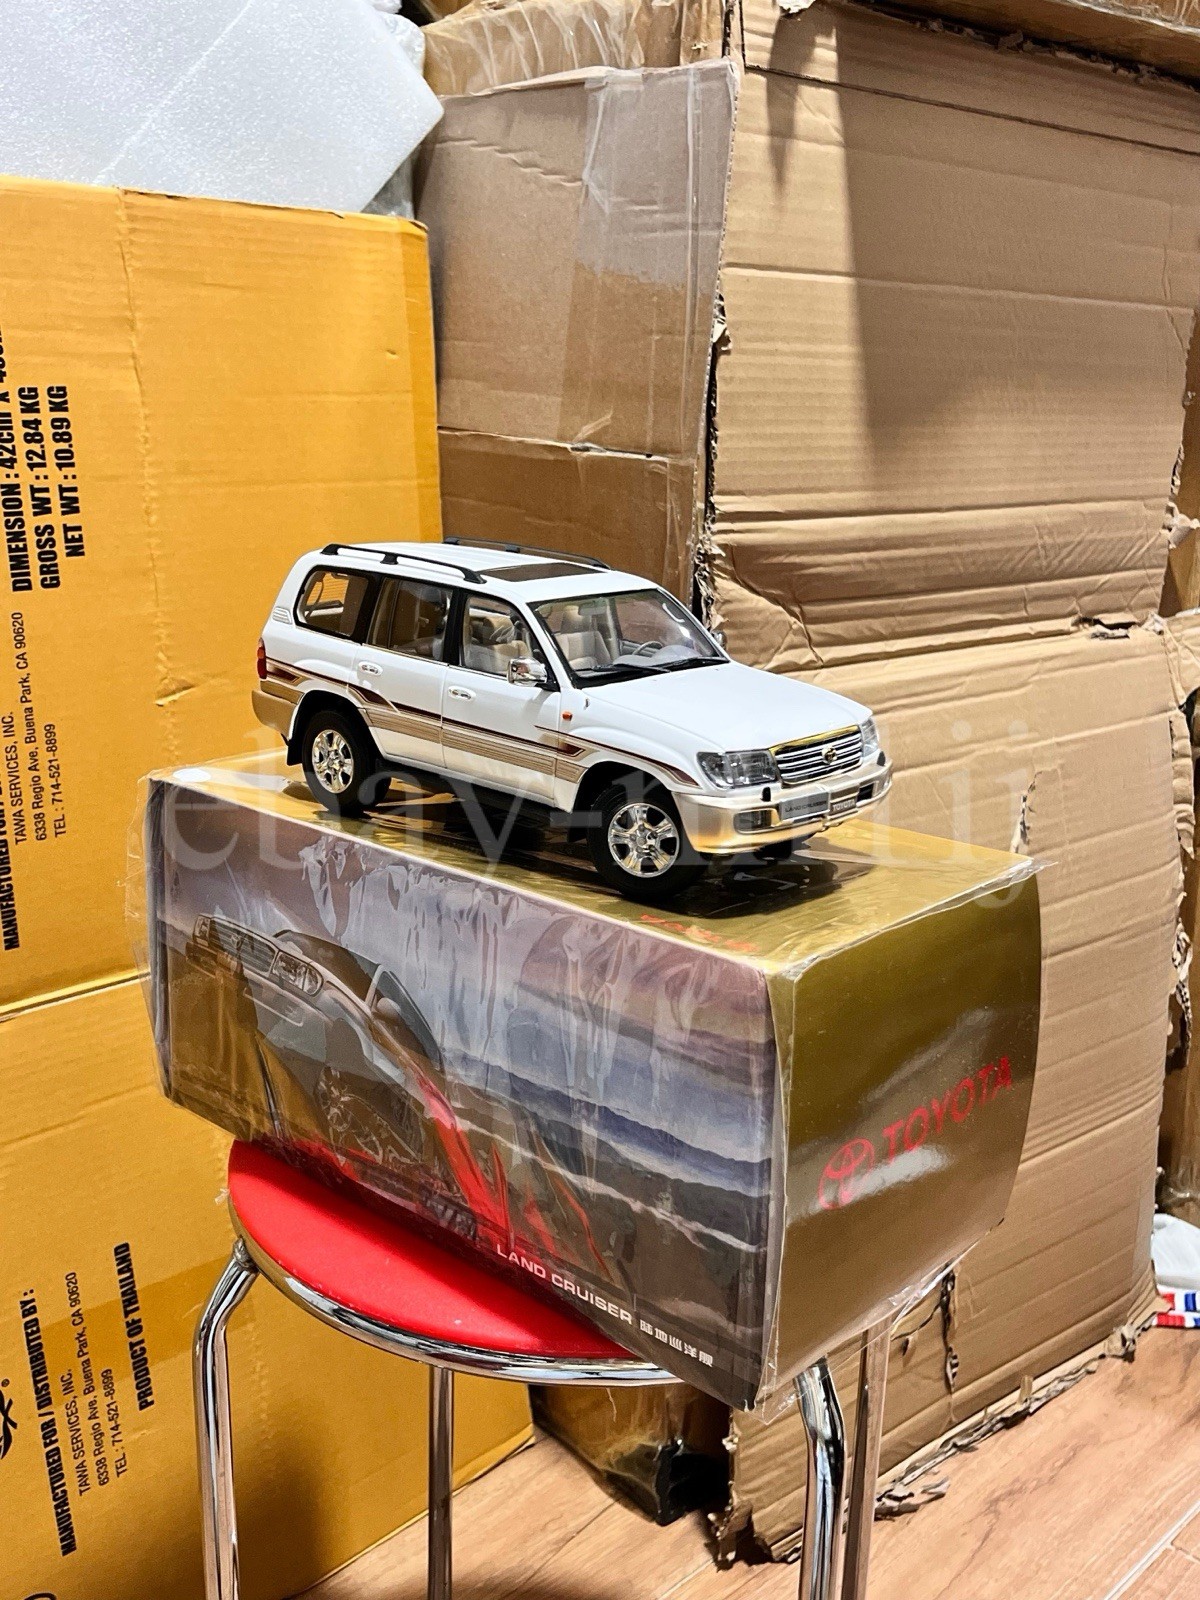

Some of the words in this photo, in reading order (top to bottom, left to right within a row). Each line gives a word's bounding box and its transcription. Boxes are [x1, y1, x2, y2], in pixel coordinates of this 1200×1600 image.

[18, 386, 40, 413] KG
[46, 385, 69, 412] KG
[22, 418, 48, 471] 12.84
[50, 417, 76, 471] 10.89
[0, 483, 33, 592] DIMENSION
[62, 523, 86, 557] NET
[34, 523, 62, 590] GROSS
[11, 612, 27, 649] 90620
[15, 651, 29, 670] CA
[18, 672, 32, 704] Park,
[1, 711, 15, 738] INC.
[24, 706, 37, 744] Buena
[5, 740, 24, 807] SERVICES,
[44, 723, 63, 805] 714-521-8899
[30, 774, 45, 810] Regio
[832, 798, 856, 811] TOYOTA
[12, 809, 28, 845] TAWA
[33, 812, 47, 841] 6338
[882, 1055, 1012, 1166] TOYOTA
[65, 1272, 80, 1307] 90620
[114, 1242, 140, 1319] THAILAND
[496, 1243, 546, 1279] LAND
[551, 1273, 633, 1325] CRUISER
[71, 1308, 84, 1327] CA
[125, 1317, 143, 1338] OF
[75, 1327, 89, 1358] Park,
[23, 1317, 53, 1410] DISTRIBUTED
[81, 1358, 95, 1396] Buena
[129, 1339, 155, 1411] PRODUCT
[60, 1368, 74, 1396] INC.
[101, 1368, 123, 1446] 714-521-8899
[41, 1419, 59, 1448] FOR
[65, 1395, 86, 1460] SERVICES,
[90, 1422, 106, 1457] Regio
[74, 1459, 91, 1496] TAWA
[96, 1457, 110, 1486] 6338
[45, 1447, 77, 1556] MANUFACTURED
